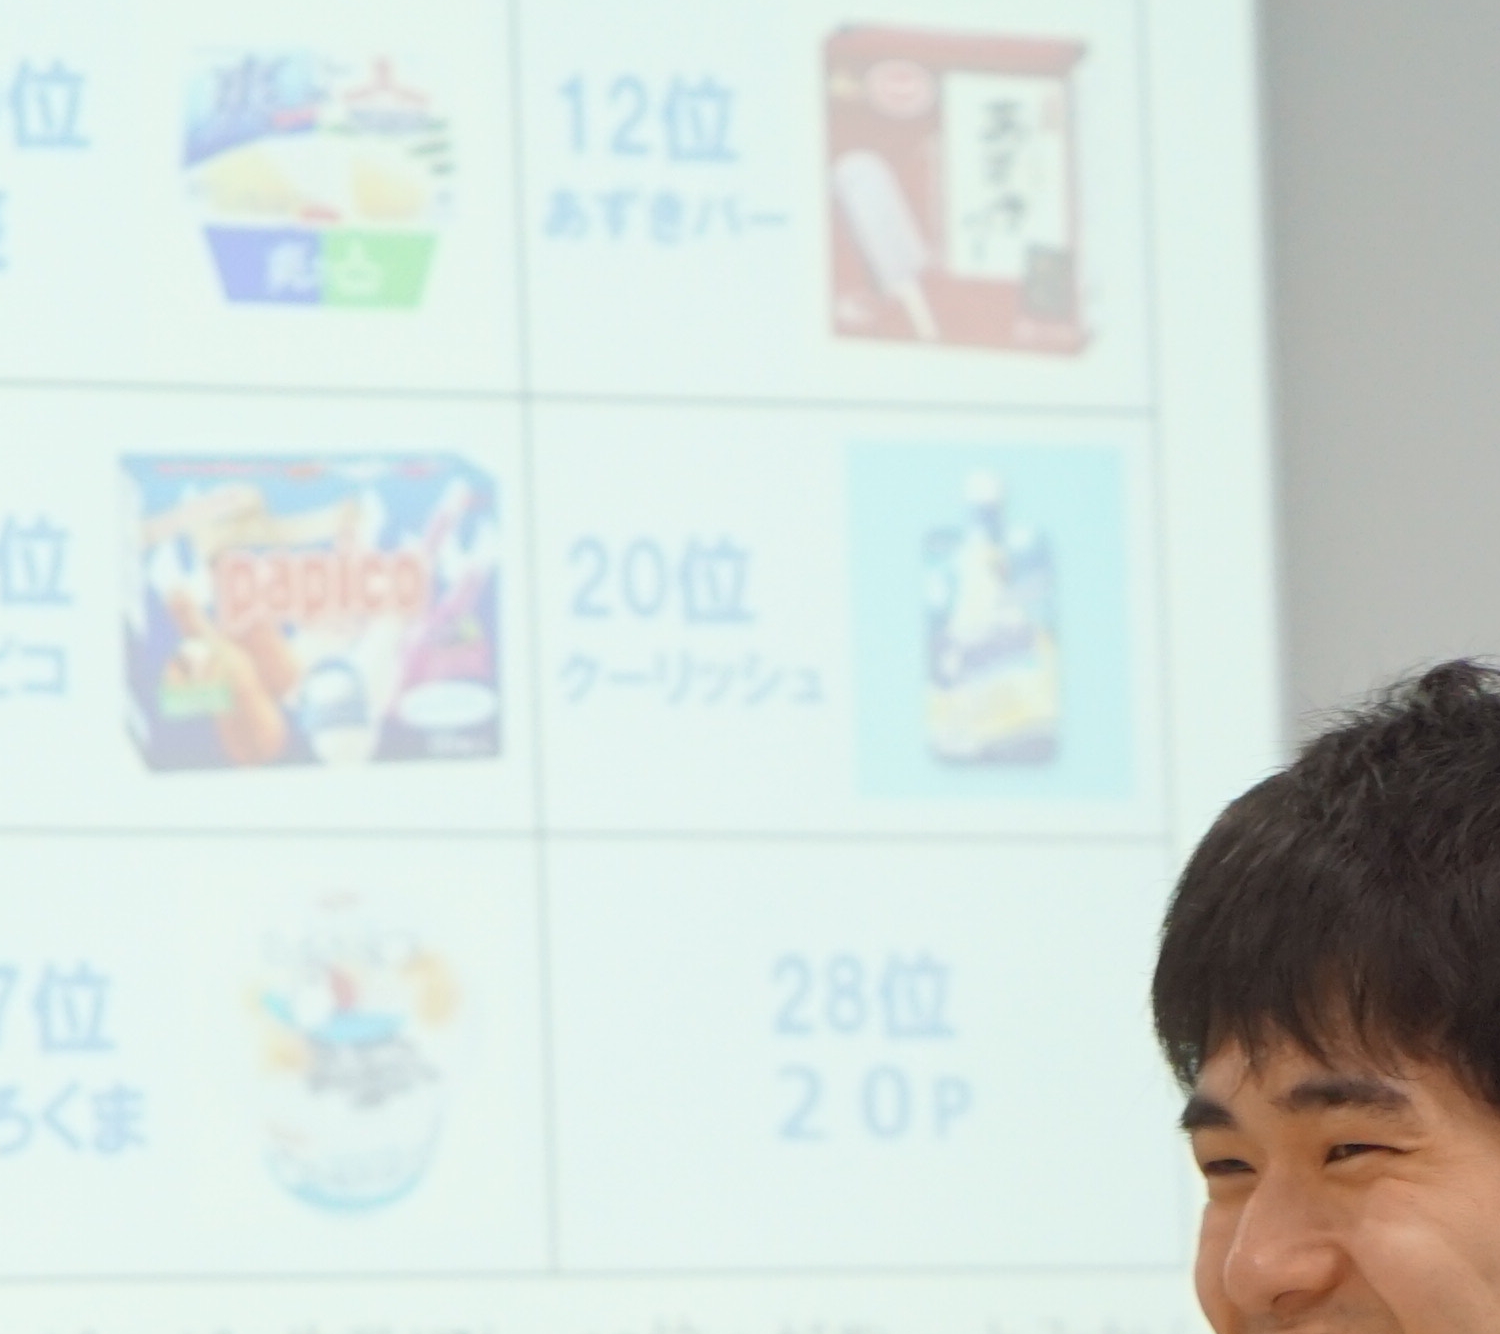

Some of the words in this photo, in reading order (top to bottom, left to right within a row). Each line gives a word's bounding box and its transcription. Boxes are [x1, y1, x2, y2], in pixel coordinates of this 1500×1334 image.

[555, 74, 739, 164] 12位
[567, 534, 756, 624] 20位
[558, 651, 826, 707] クーリッシュ
[769, 951, 957, 1039] 28位
